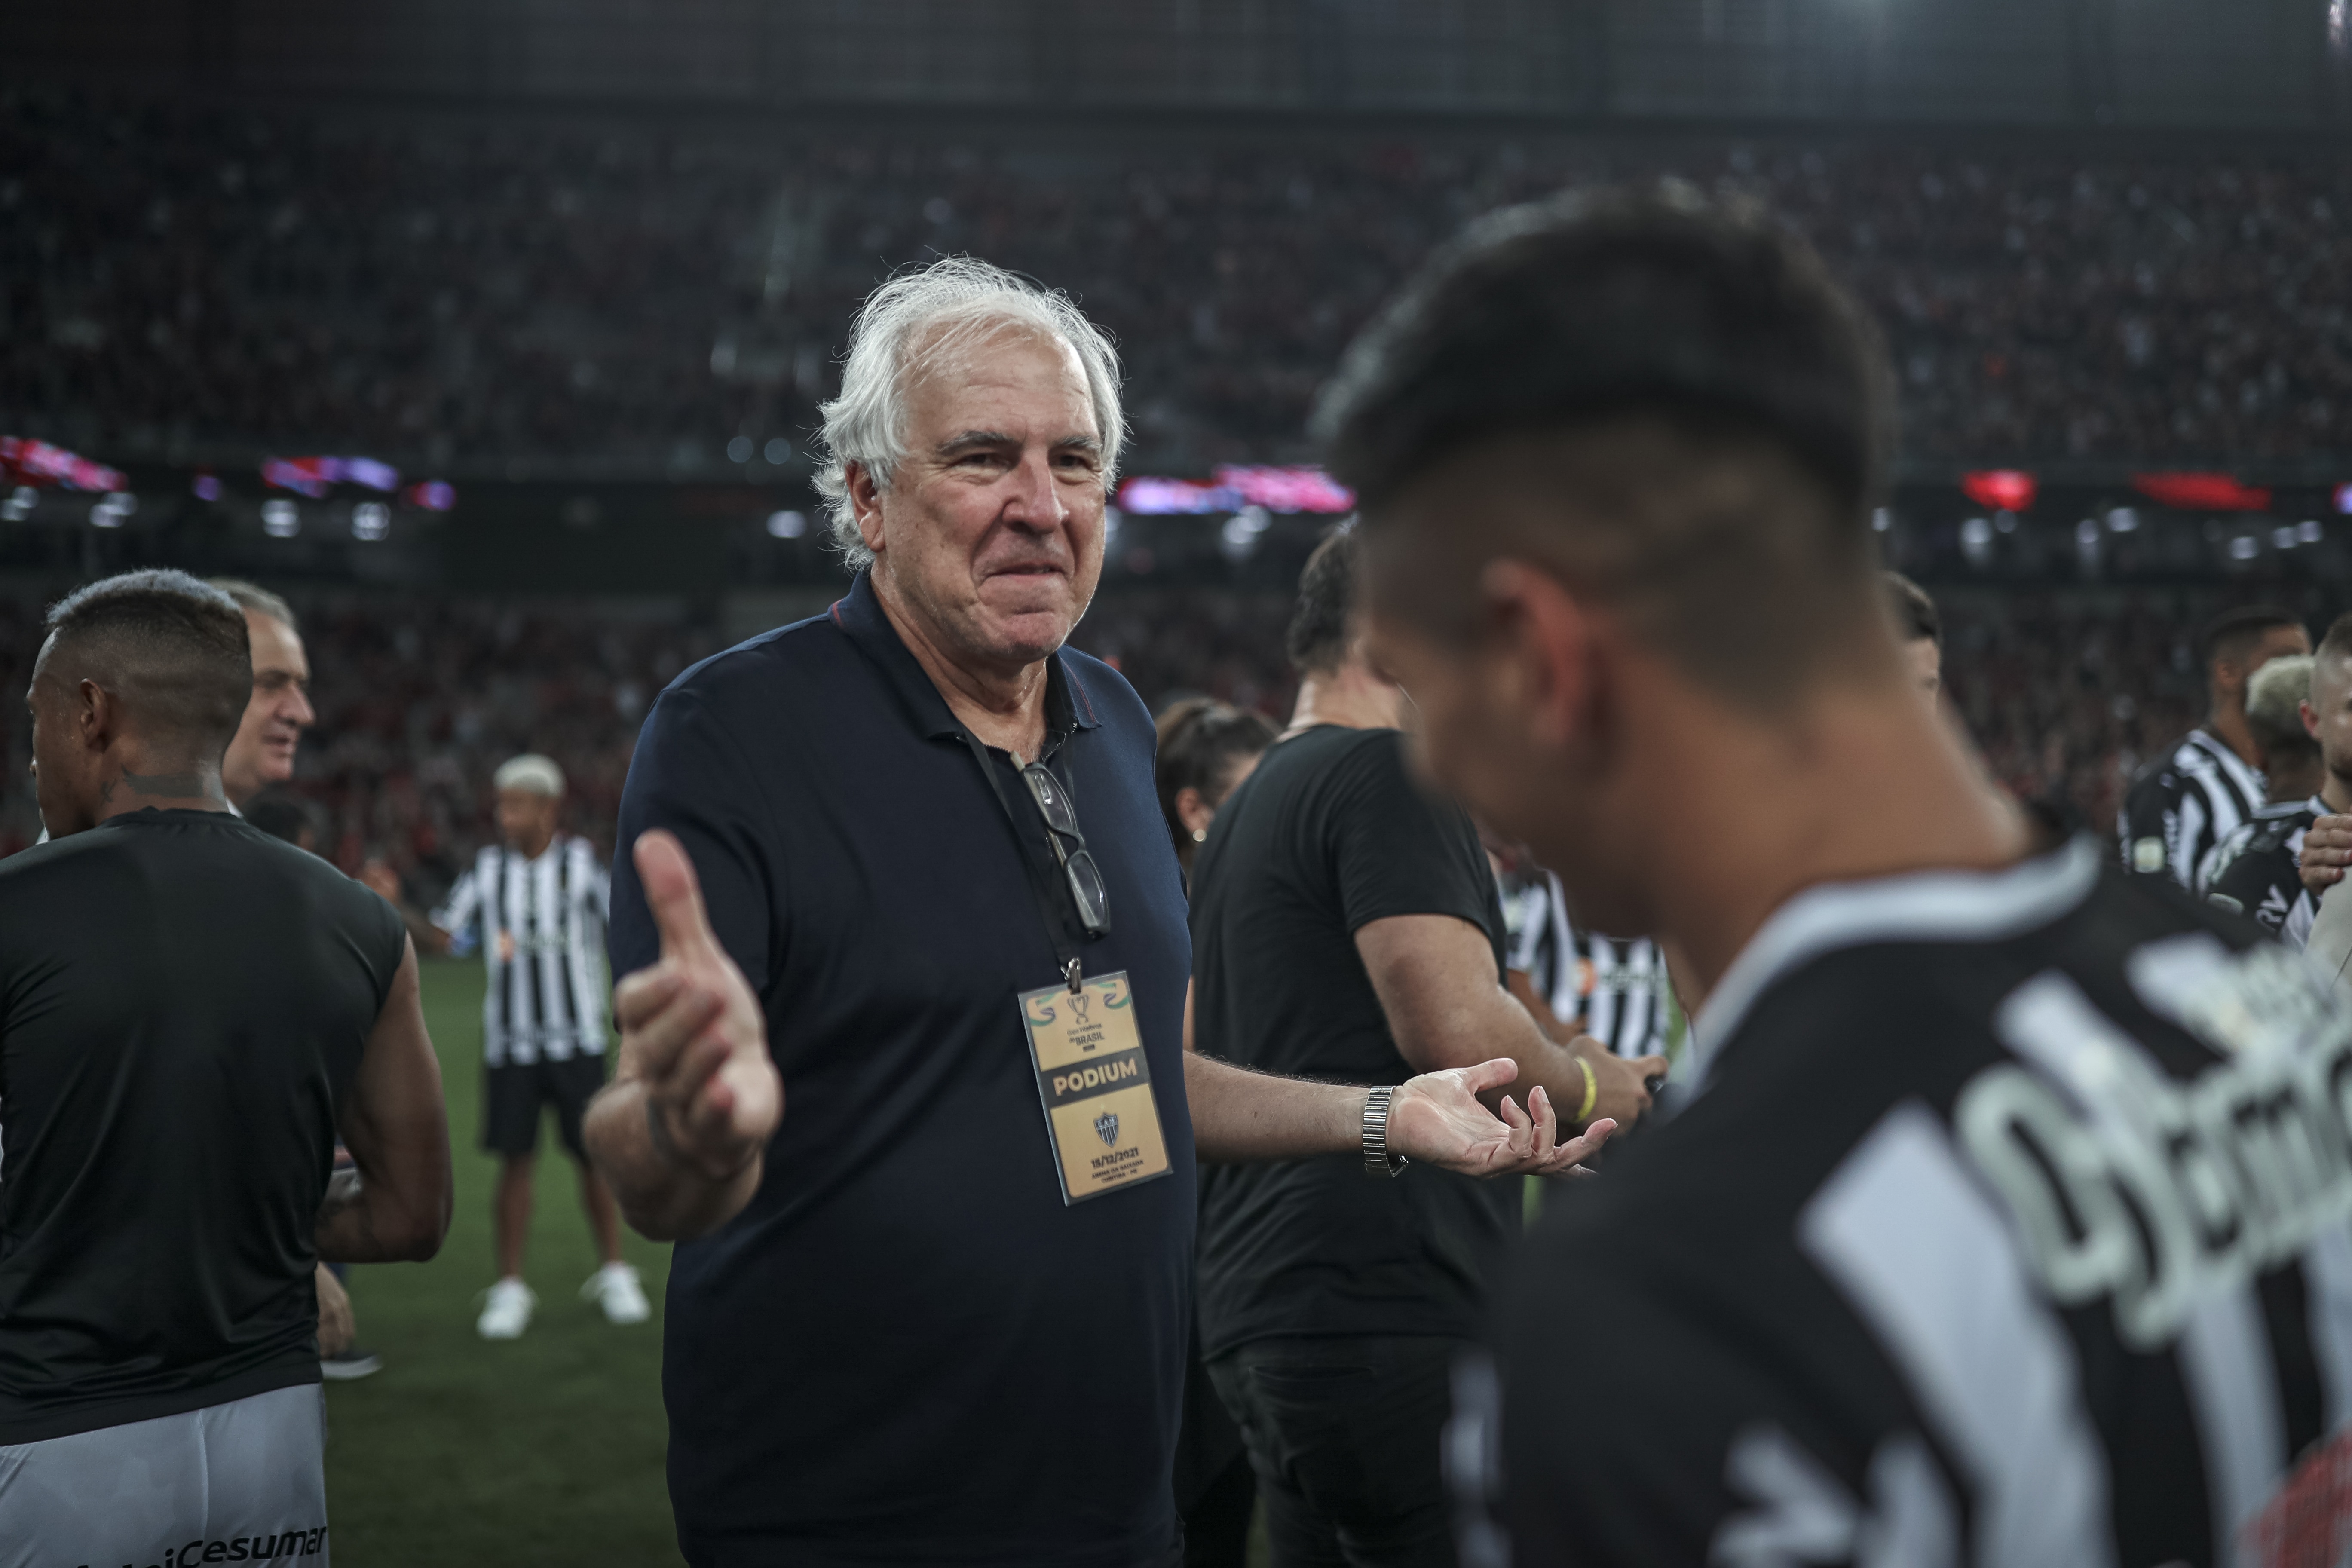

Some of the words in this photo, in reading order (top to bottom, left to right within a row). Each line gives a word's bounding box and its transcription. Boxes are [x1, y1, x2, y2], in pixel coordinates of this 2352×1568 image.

[2255, 884, 2288, 931] RV
[1075, 1031, 1104, 1045] BRASIL
[1053, 1057, 1137, 1096] PODIUM
[1097, 1118, 1115, 1127] CAM
[1091, 1146, 1139, 1169] 15/12/2021
[77, 1526, 327, 1568] iCesumar
